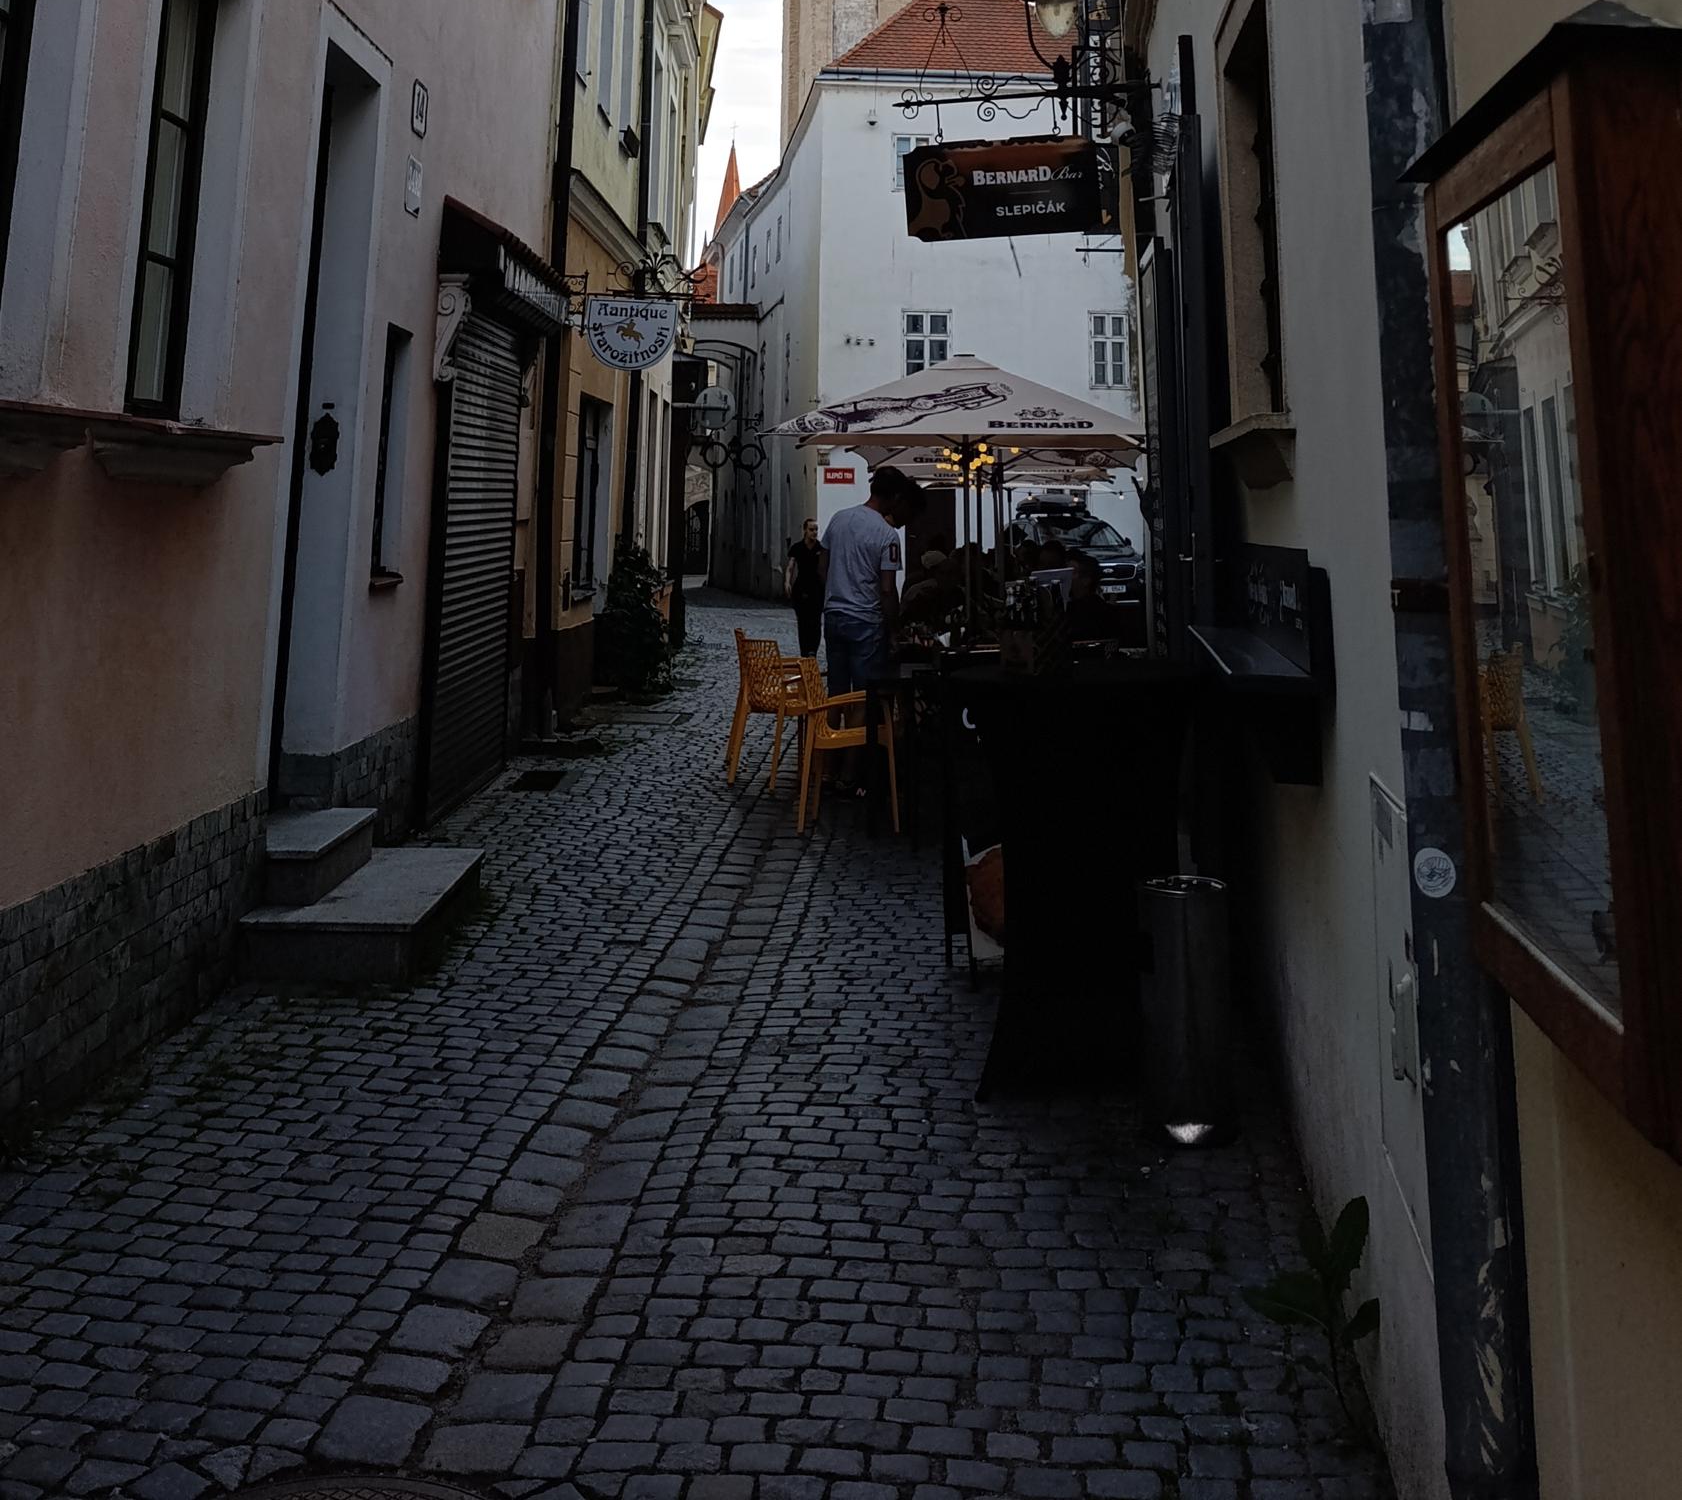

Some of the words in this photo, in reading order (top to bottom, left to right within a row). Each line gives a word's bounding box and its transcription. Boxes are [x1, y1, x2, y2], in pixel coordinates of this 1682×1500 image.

[415, 88, 425, 124] 14
[972, 165, 1051, 186] BERNARD
[1051, 164, 1083, 181] Bar
[996, 200, 1066, 216] SLEPIČÁK
[598, 303, 668, 321] Aantique
[593, 322, 670, 364] Starožitnosti
[988, 420, 1094, 429] BERNARD
